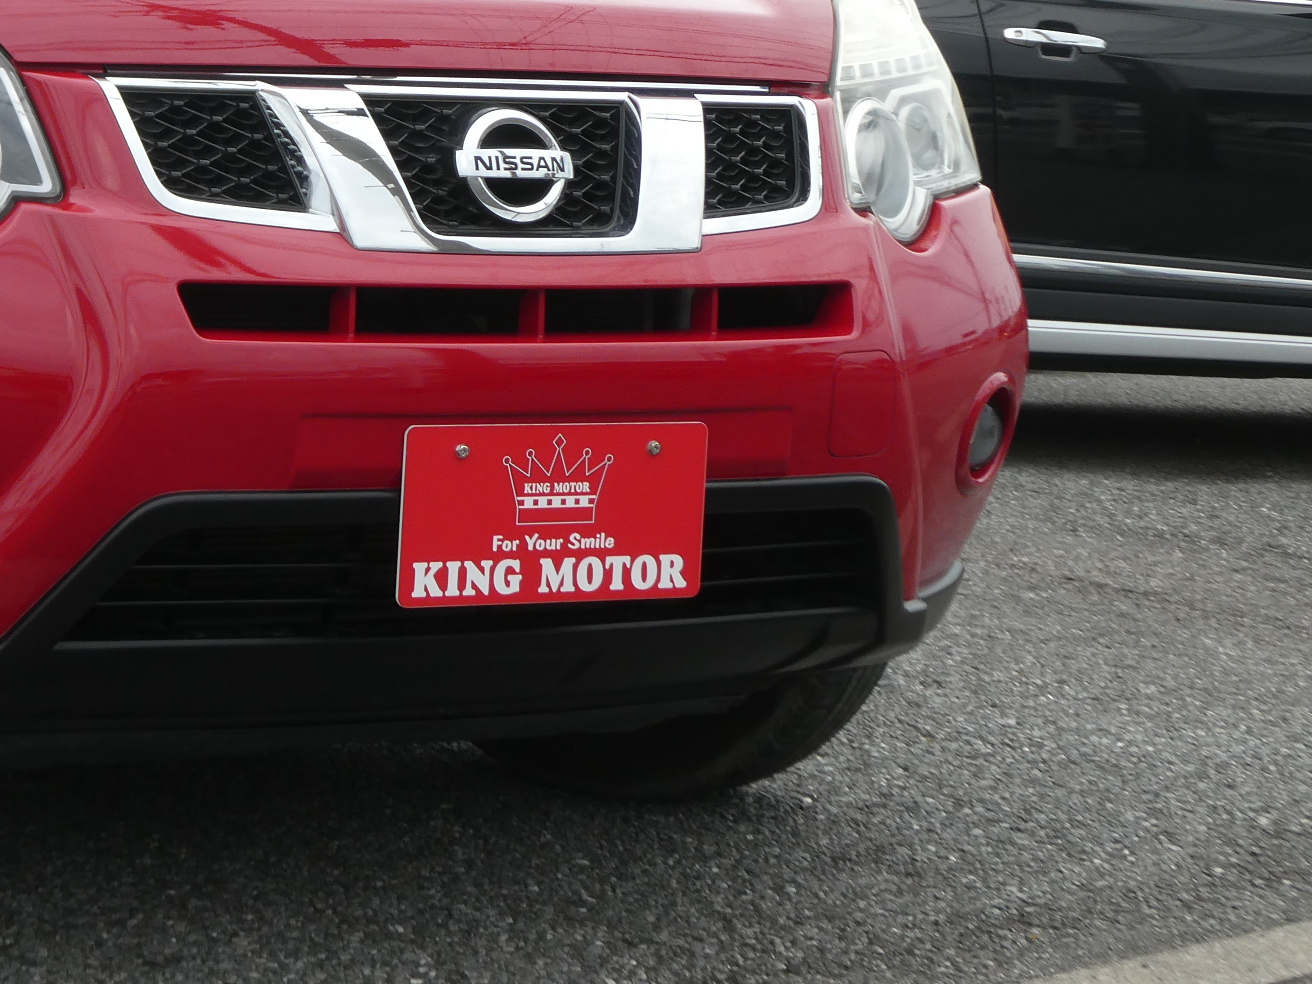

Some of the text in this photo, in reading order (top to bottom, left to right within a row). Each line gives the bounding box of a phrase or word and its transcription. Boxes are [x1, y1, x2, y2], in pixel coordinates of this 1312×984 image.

[473, 155, 566, 173] NISSAN
[523, 481, 591, 494] KING MOTOR
[492, 532, 615, 552] For Your Smile
[411, 553, 687, 599] KING MOTOR
